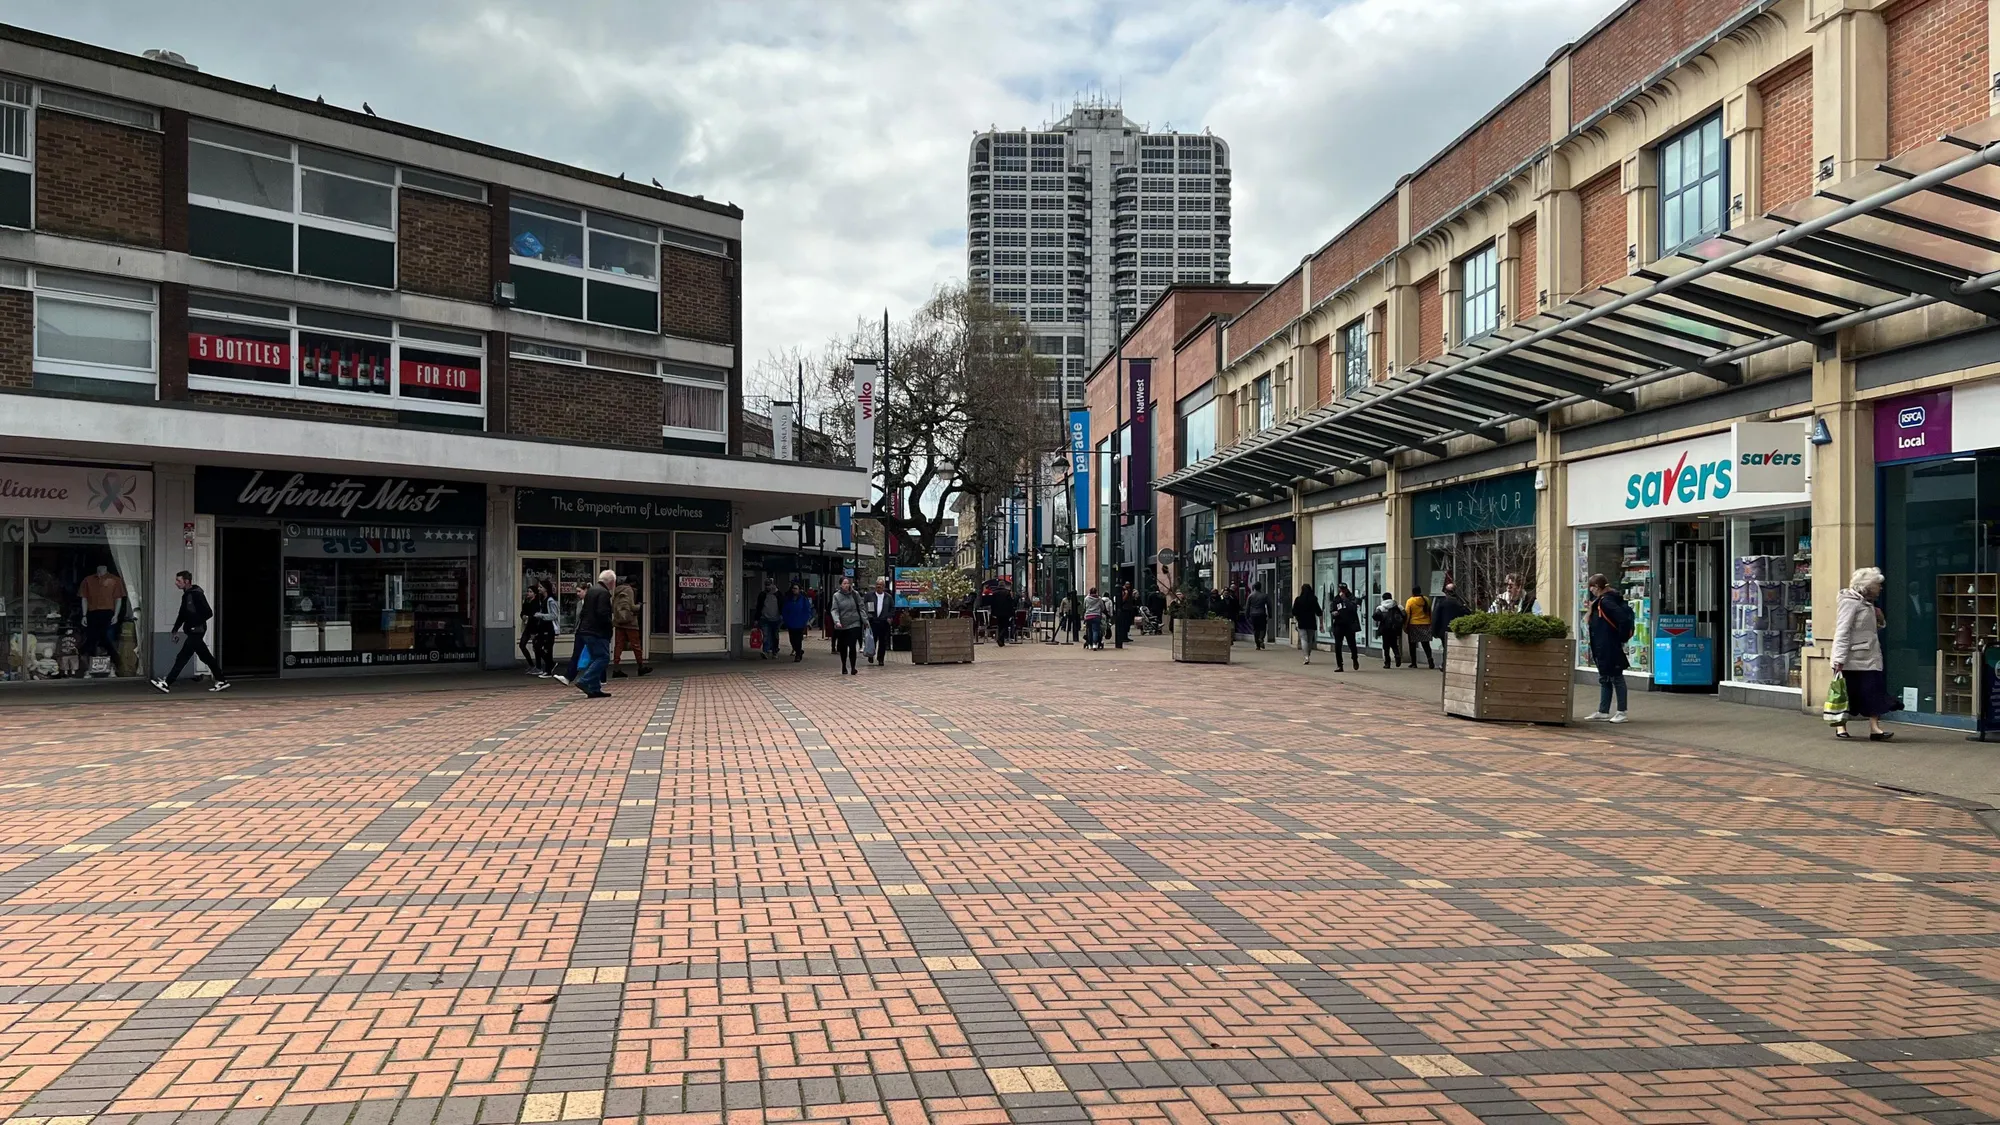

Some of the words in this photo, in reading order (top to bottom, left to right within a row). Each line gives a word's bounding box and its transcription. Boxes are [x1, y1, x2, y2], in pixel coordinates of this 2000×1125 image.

[200, 336, 207, 357] 5
[216, 338, 281, 365] BOTTLES
[416, 364, 439, 385] FOR
[445, 369, 466, 388] £10
[858, 382, 872, 419] wilko
[1136, 379, 1145, 413] NatWest
[1901, 412, 1923, 423] RSPCA
[1073, 422, 1088, 473] parade
[1898, 432, 1925, 449] Local
[1740, 449, 1801, 466] savers
[237, 470, 366, 518] Infinity
[357, 479, 459, 513] Mist
[1625, 450, 1732, 510] savers
[551, 496, 573, 512] The
[576, 498, 637, 517] Emporium
[640, 503, 652, 519] of
[654, 503, 703, 519] Loveliness
[1435, 491, 1522, 521] SURVIVOR
[359, 526, 380, 539] OPEN
[383, 527, 388, 539] 7
[391, 528, 411, 540] DAYS
